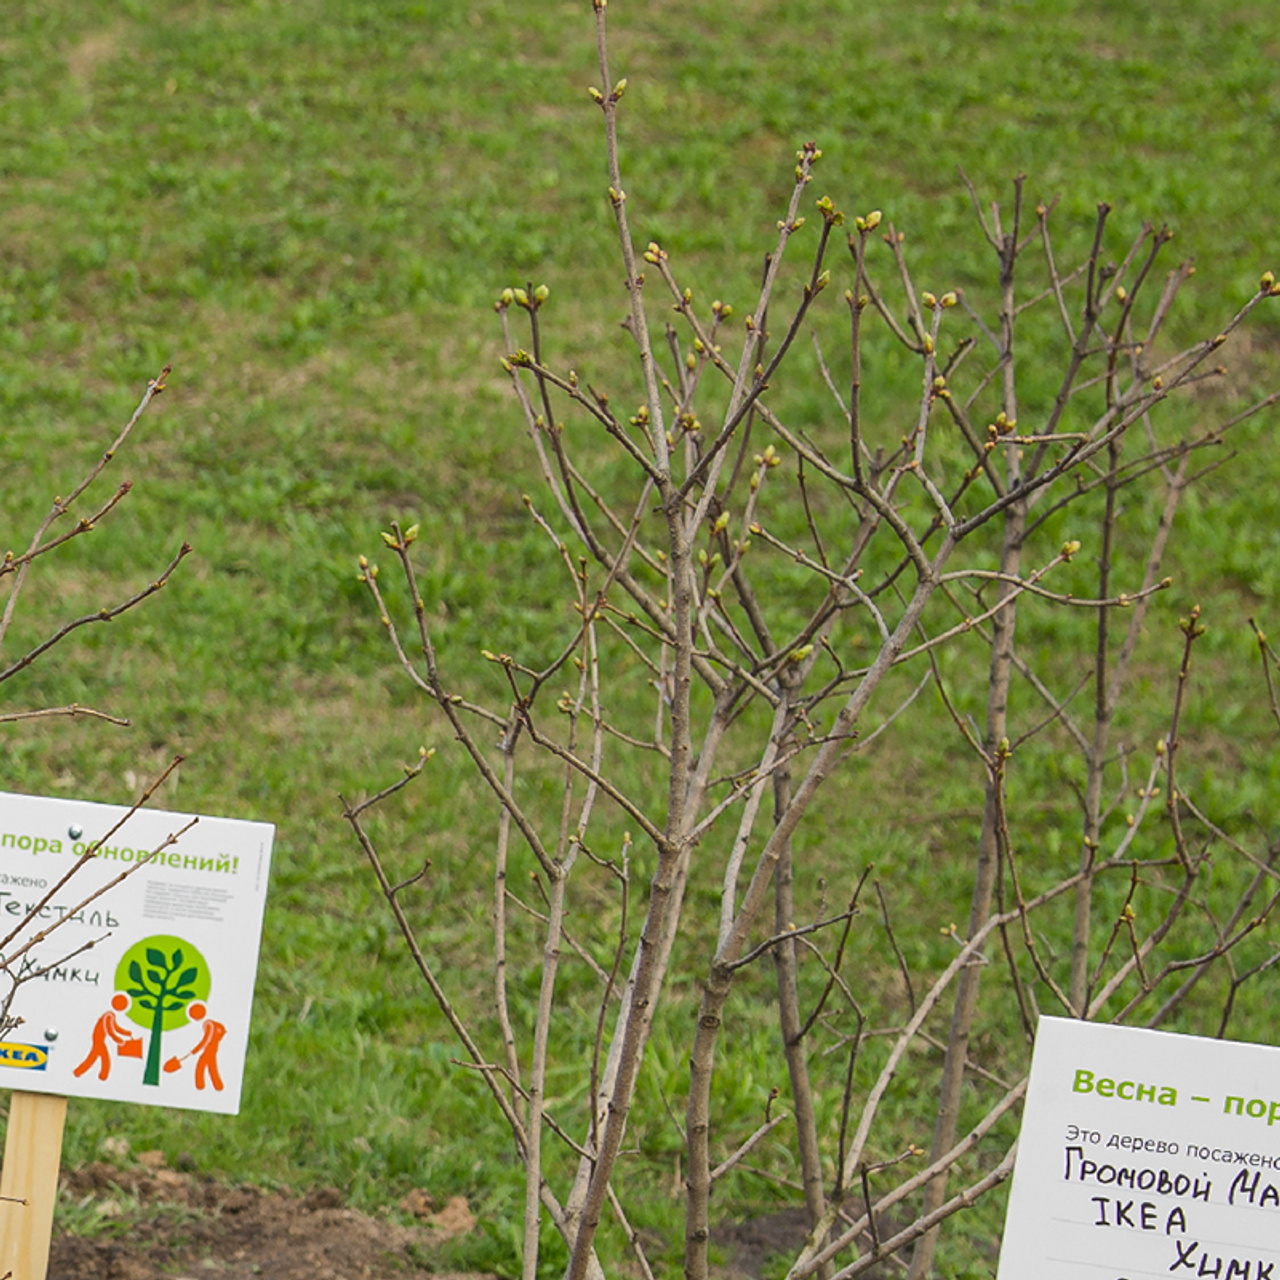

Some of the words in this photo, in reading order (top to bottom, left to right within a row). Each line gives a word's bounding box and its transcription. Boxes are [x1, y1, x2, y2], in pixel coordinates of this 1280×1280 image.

[2, 834, 62, 855] пора
[1073, 1069, 1177, 1106] Весна
[1066, 1125, 1101, 1144] Это
[1106, 1135, 1179, 1154] дерево
[1091, 1197, 1186, 1235] IKEA
